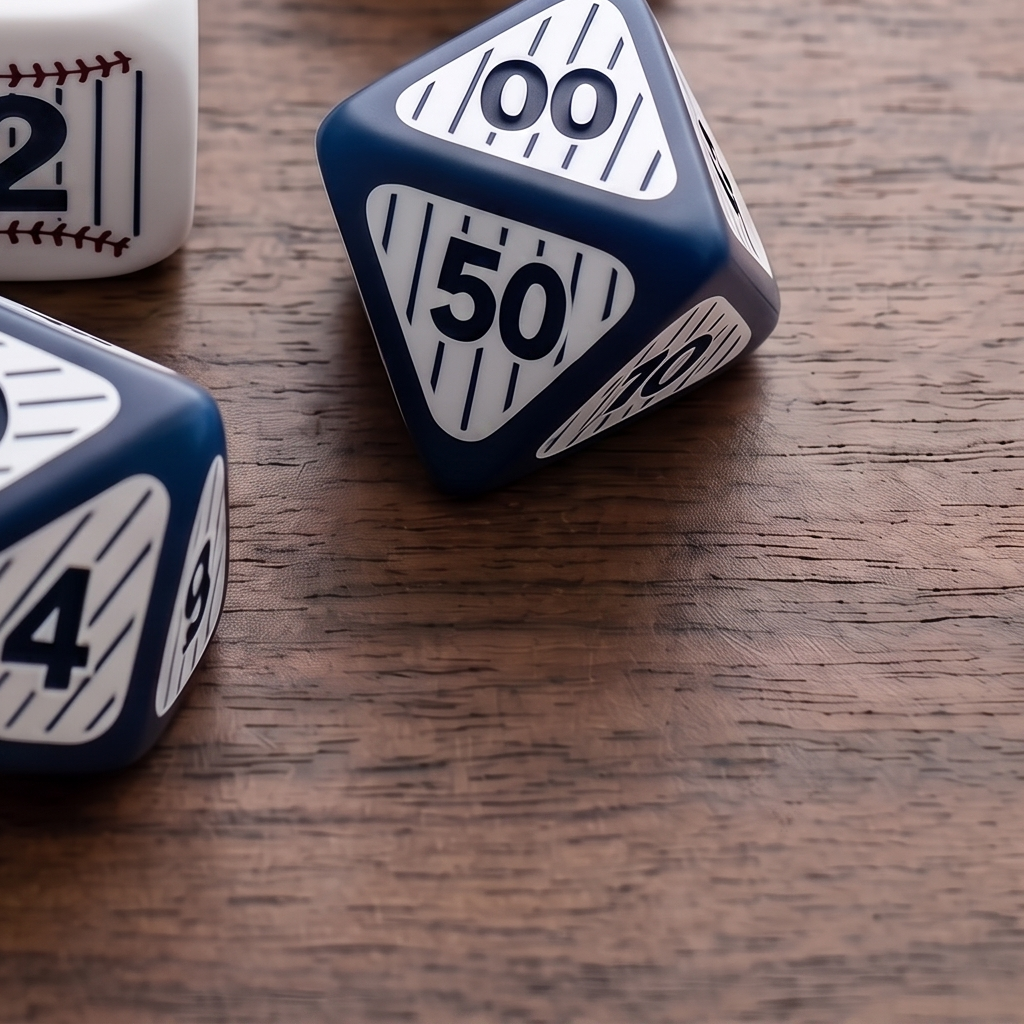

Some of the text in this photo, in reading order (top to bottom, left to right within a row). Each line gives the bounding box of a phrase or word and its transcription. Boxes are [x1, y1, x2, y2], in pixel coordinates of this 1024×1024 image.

[480, 59, 617, 140] 00
[429, 236, 567, 360] 50
[0, 567, 90, 690] 4
